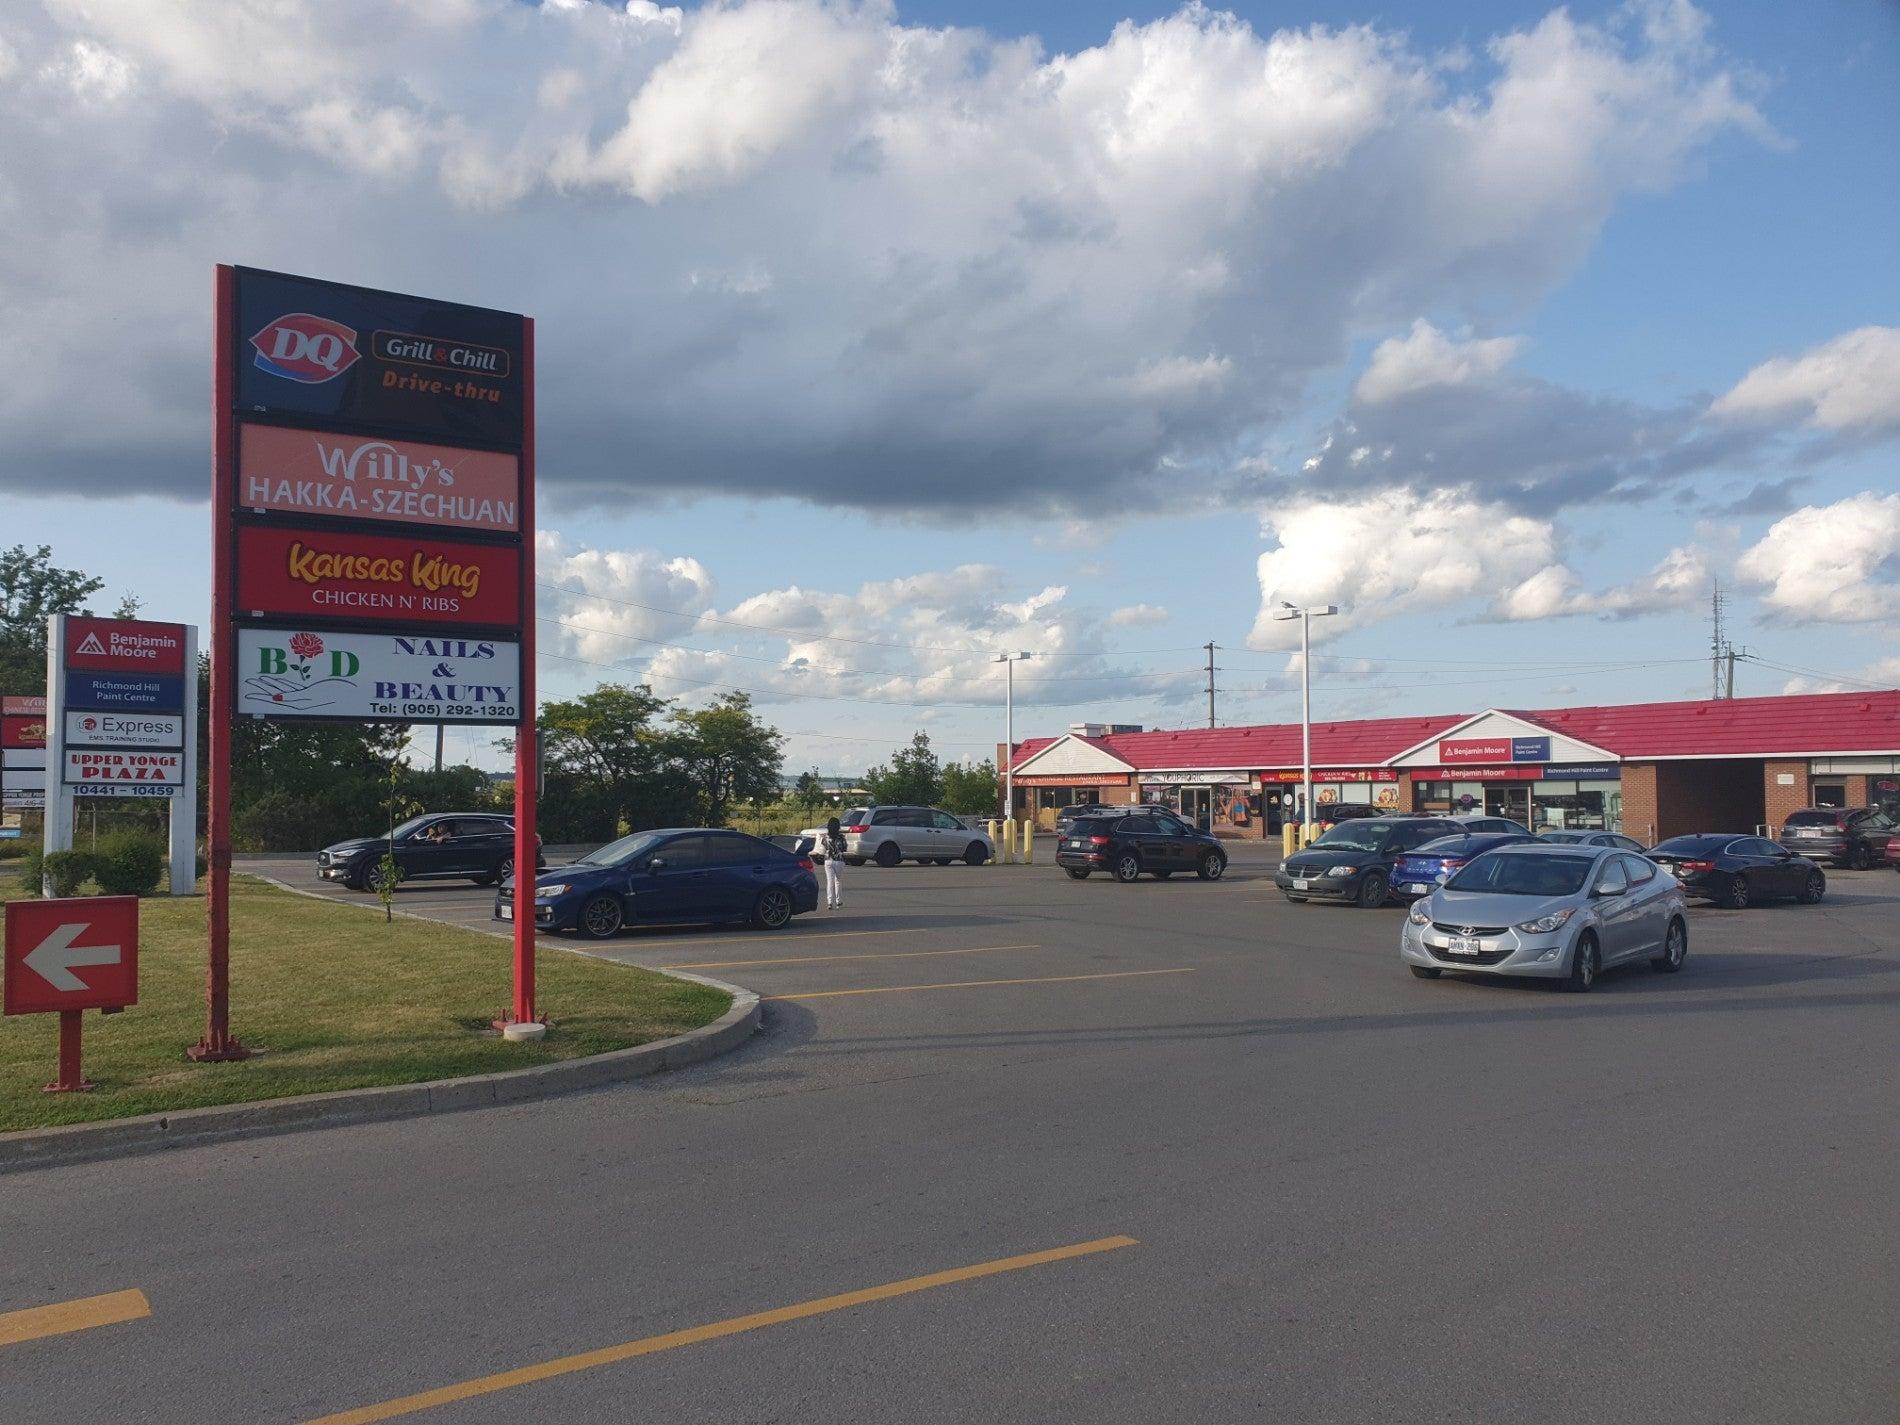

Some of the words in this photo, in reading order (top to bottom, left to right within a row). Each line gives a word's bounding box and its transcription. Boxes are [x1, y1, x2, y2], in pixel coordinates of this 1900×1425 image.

[273, 327, 346, 372] DQ
[386, 338, 433, 361] Grill
[449, 348, 497, 371] Chill
[382, 371, 500, 402] Drive-thru
[318, 442, 455, 490] Willy's
[249, 476, 515, 525] HAKKA-SZECHUAN
[289, 543, 404, 583] Kansas
[412, 552, 481, 598] King
[312, 589, 394, 609] CHICKEN
[399, 595, 417, 609] N'
[422, 596, 460, 612] RIBS
[110, 632, 177, 648] Benjamin
[110, 645, 157, 658] Moore
[392, 637, 496, 660] NAILS
[257, 646, 288, 675] B
[331, 650, 360, 677] D
[432, 662, 456, 678] &
[92, 680, 142, 691] Richmond
[144, 682, 160, 692] Hill
[374, 681, 513, 703] BEAUTY
[97, 691, 122, 701] Paint
[124, 692, 156, 702] Centre
[370, 702, 397, 715] Tel:
[402, 703, 441, 717] (905)
[446, 704, 515, 717] 292-1320
[102, 717, 174, 735] Express
[106, 735, 137, 743] TRAINING
[1454, 747, 1483, 756] Benjamin
[1484, 746, 1505, 754] Moore
[71, 754, 124, 765] UPPER
[129, 756, 177, 767] YONGE
[82, 766, 166, 780] PLAZA
[1451, 769, 1482, 778] Benjamin
[72, 785, 115, 795] 10441
[133, 786, 174, 796] 10459
